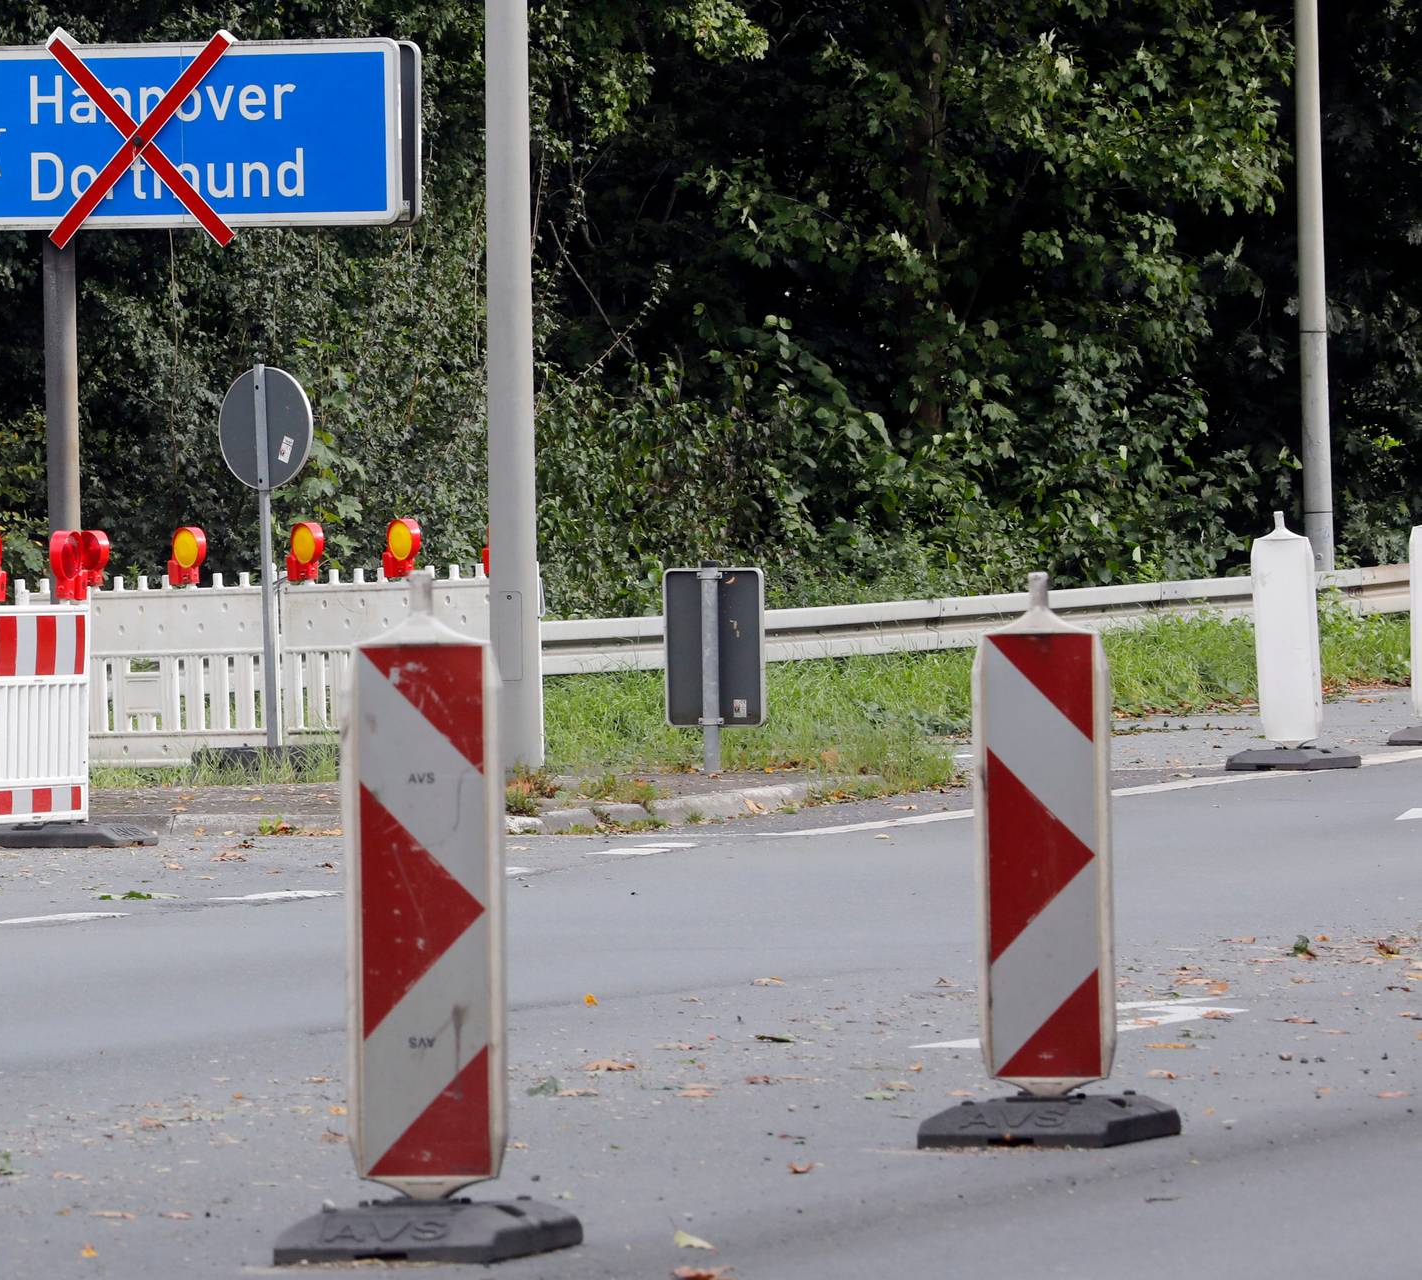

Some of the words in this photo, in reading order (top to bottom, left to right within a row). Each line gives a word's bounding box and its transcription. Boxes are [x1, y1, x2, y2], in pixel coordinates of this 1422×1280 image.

[408, 772, 435, 784] AVS
[408, 1037, 436, 1049] AVS
[959, 1108, 1066, 1129] AVS
[323, 1218, 449, 1243] AVS
